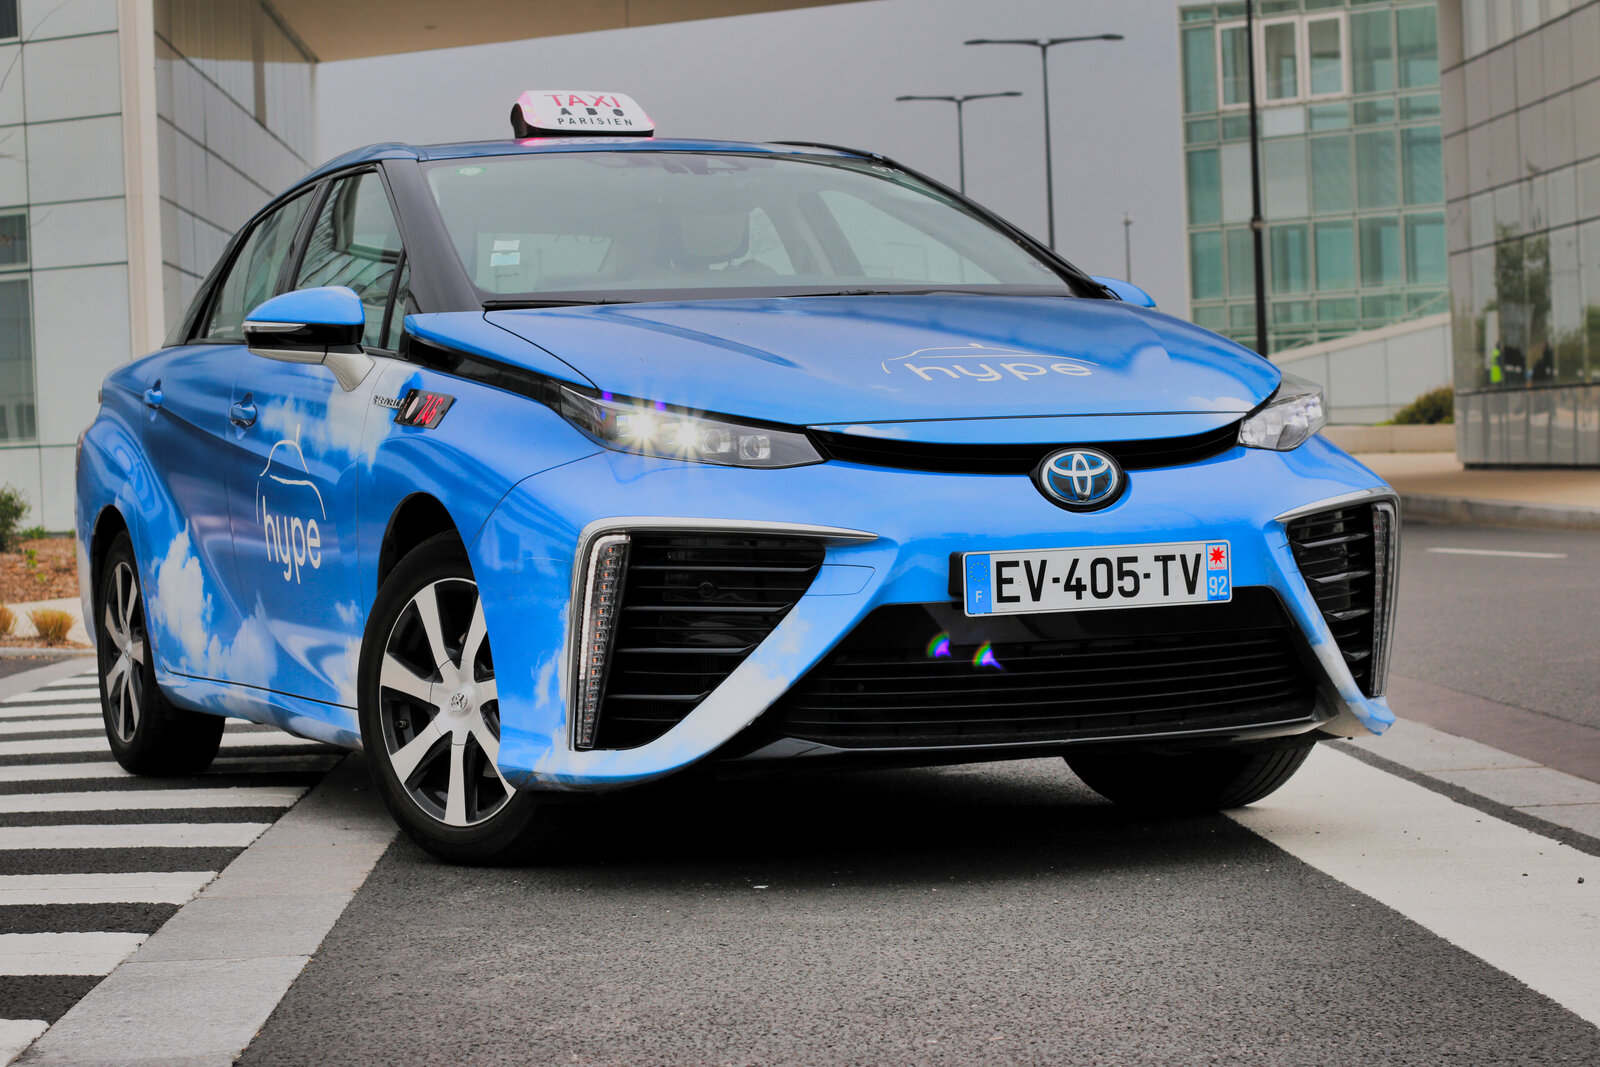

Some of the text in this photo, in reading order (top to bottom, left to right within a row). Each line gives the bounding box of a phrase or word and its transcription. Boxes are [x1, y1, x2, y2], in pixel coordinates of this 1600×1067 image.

[544, 94, 621, 107] TAXI
[557, 117, 633, 126] PARISIEN
[903, 363, 1092, 381] hype
[262, 495, 321, 584] hype
[995, 553, 1202, 604] EV-405-TV
[1209, 575, 1228, 596] 92
[975, 590, 983, 604] F
